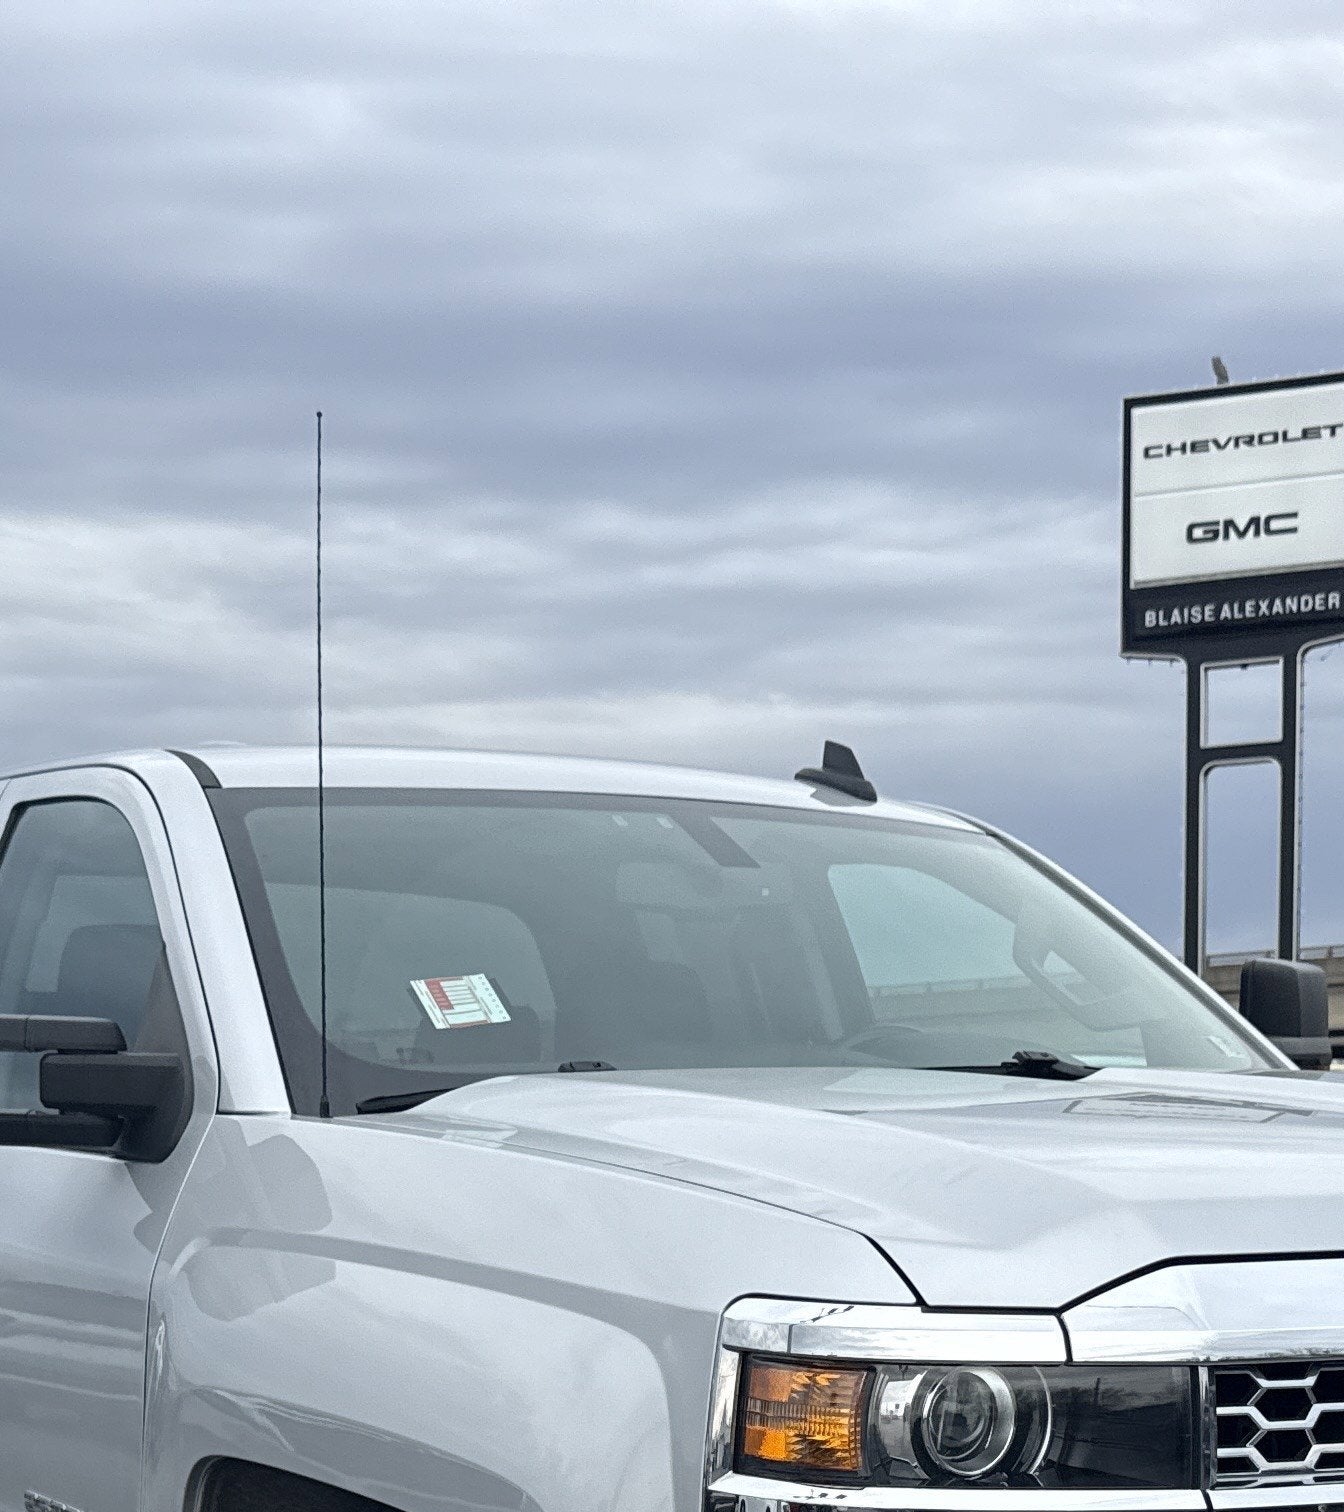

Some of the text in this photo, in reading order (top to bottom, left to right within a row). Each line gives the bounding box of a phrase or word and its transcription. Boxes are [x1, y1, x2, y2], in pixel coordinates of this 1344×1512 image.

[1143, 422, 1343, 459] CHEVROLET
[1186, 511, 1298, 544] GMC
[1144, 592, 1341, 628] BLAISE ALEXANDER
